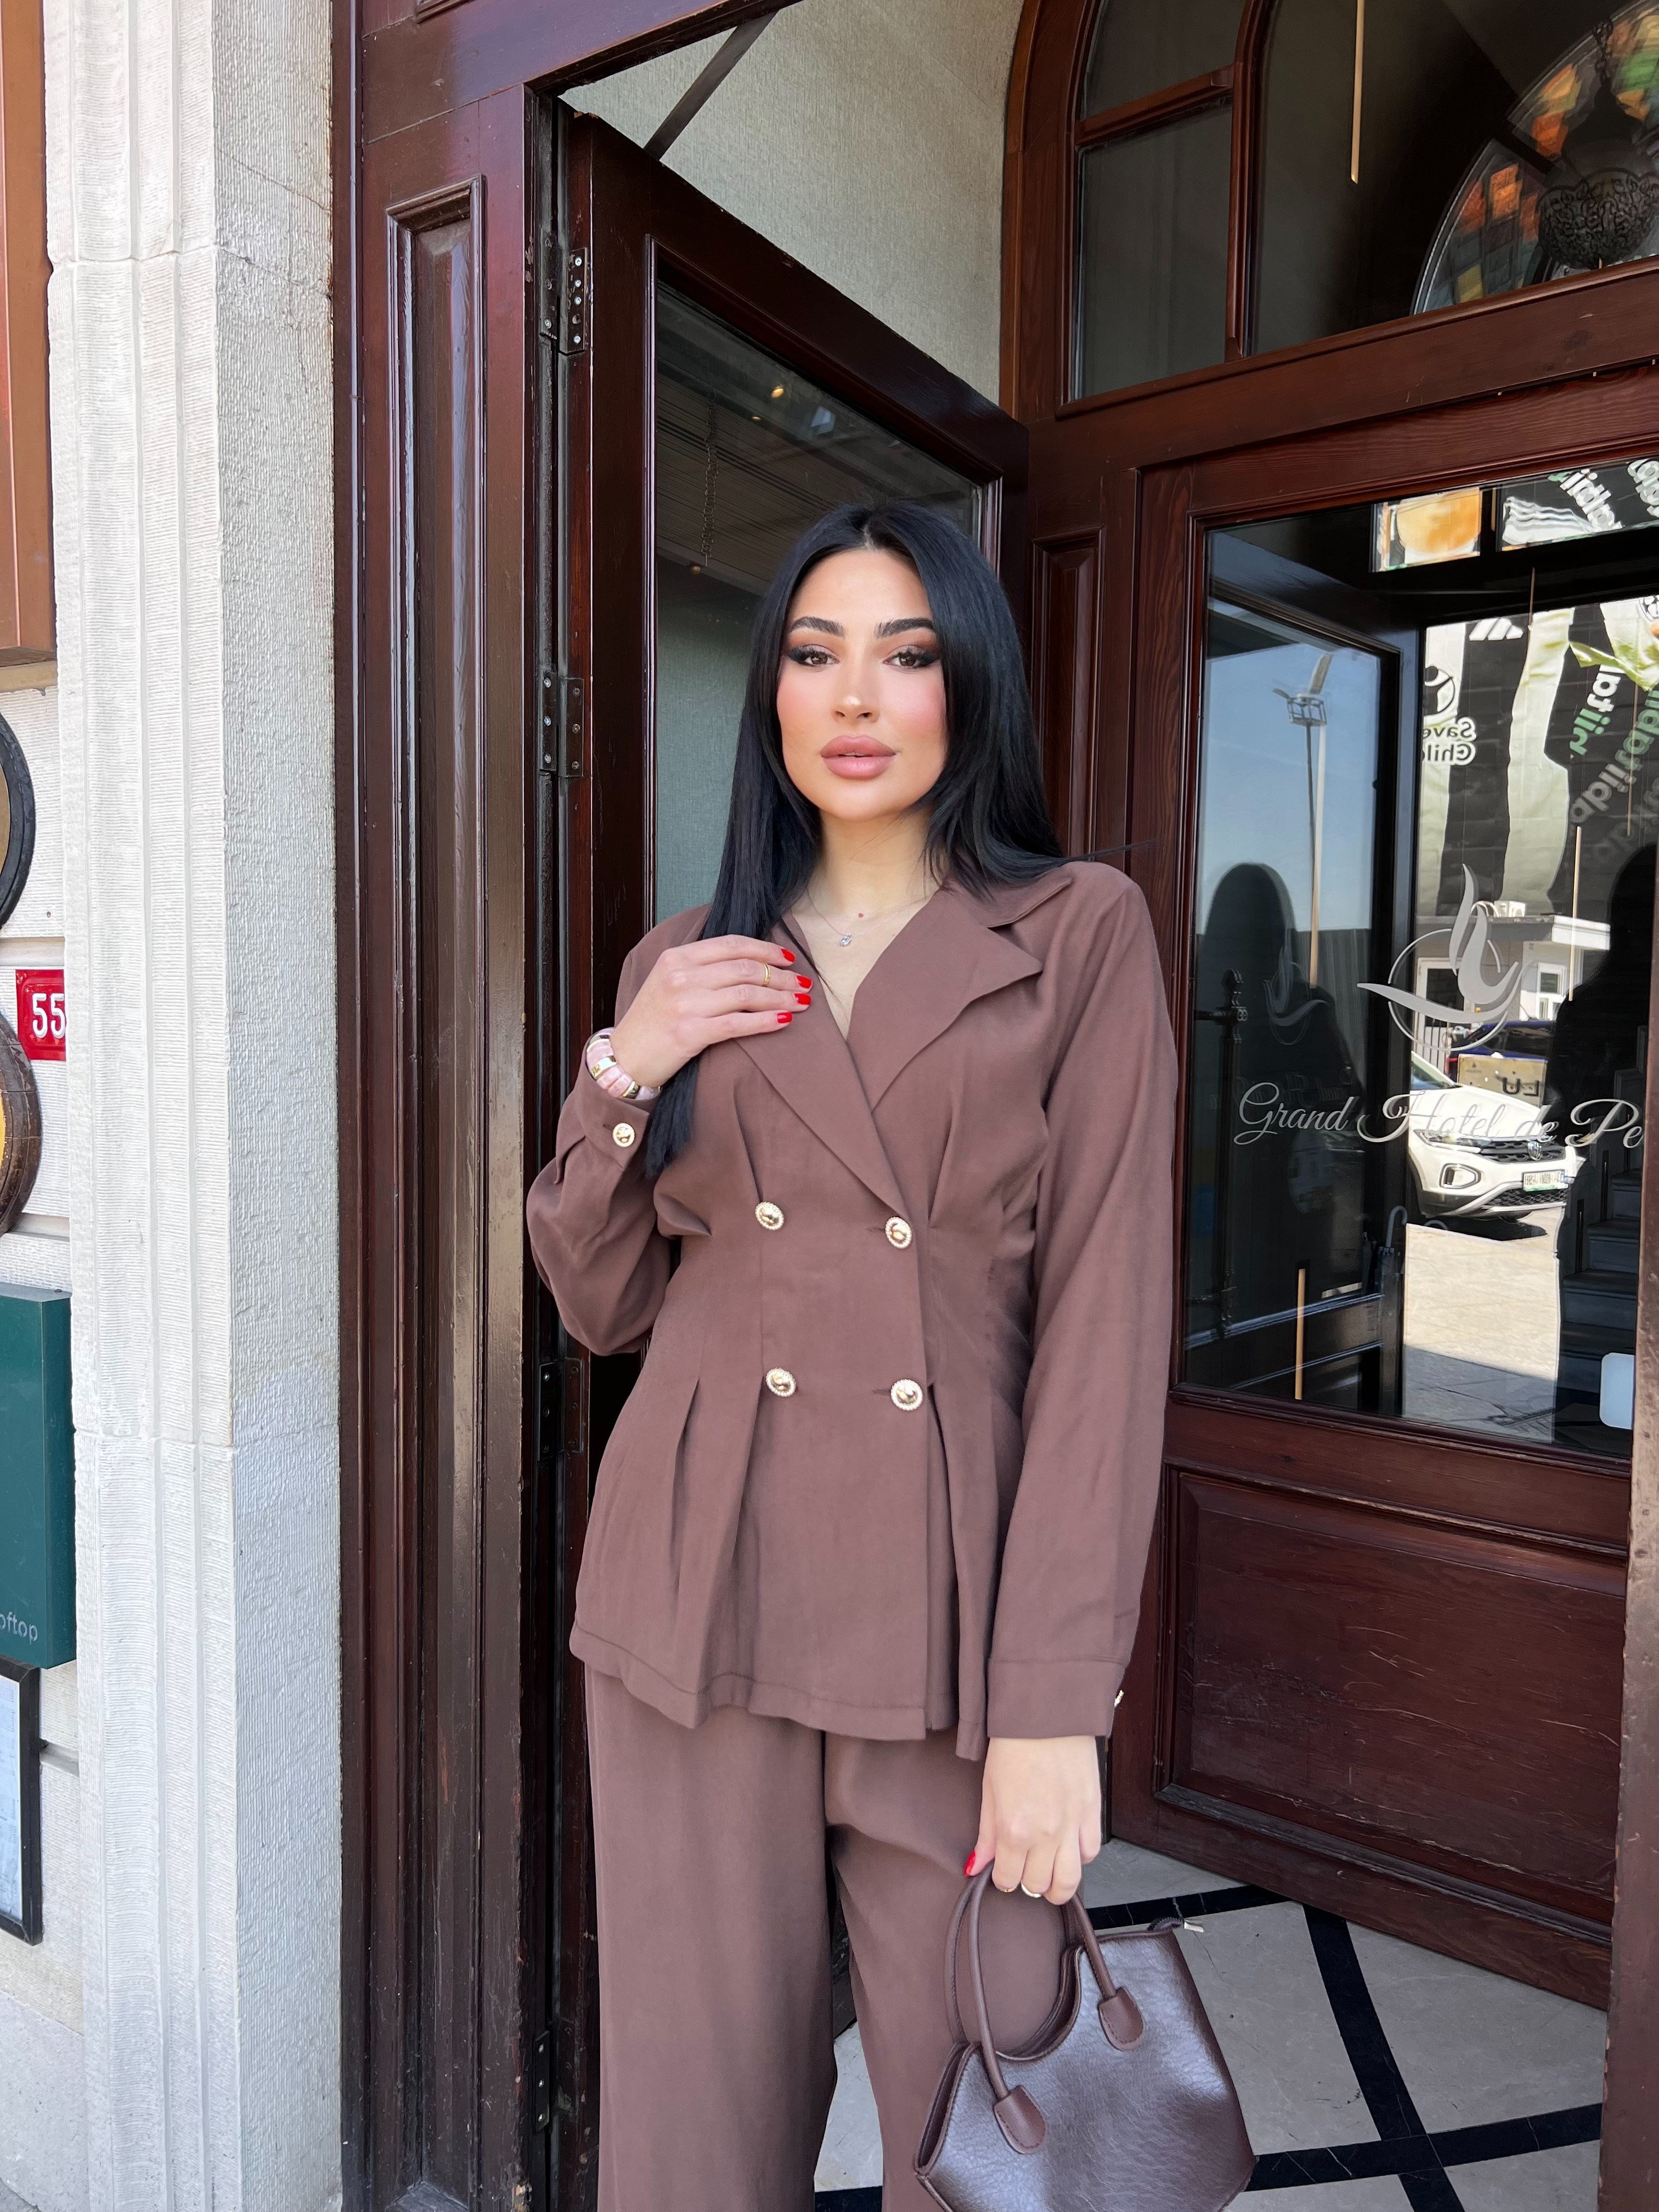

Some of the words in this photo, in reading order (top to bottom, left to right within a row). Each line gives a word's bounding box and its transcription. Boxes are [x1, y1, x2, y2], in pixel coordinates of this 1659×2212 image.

[32, 992, 66, 1039] 55
[1233, 1082, 1356, 1146] Grand
[1356, 1090, 1508, 1143] Hotel
[1513, 1104, 1560, 1143] de
